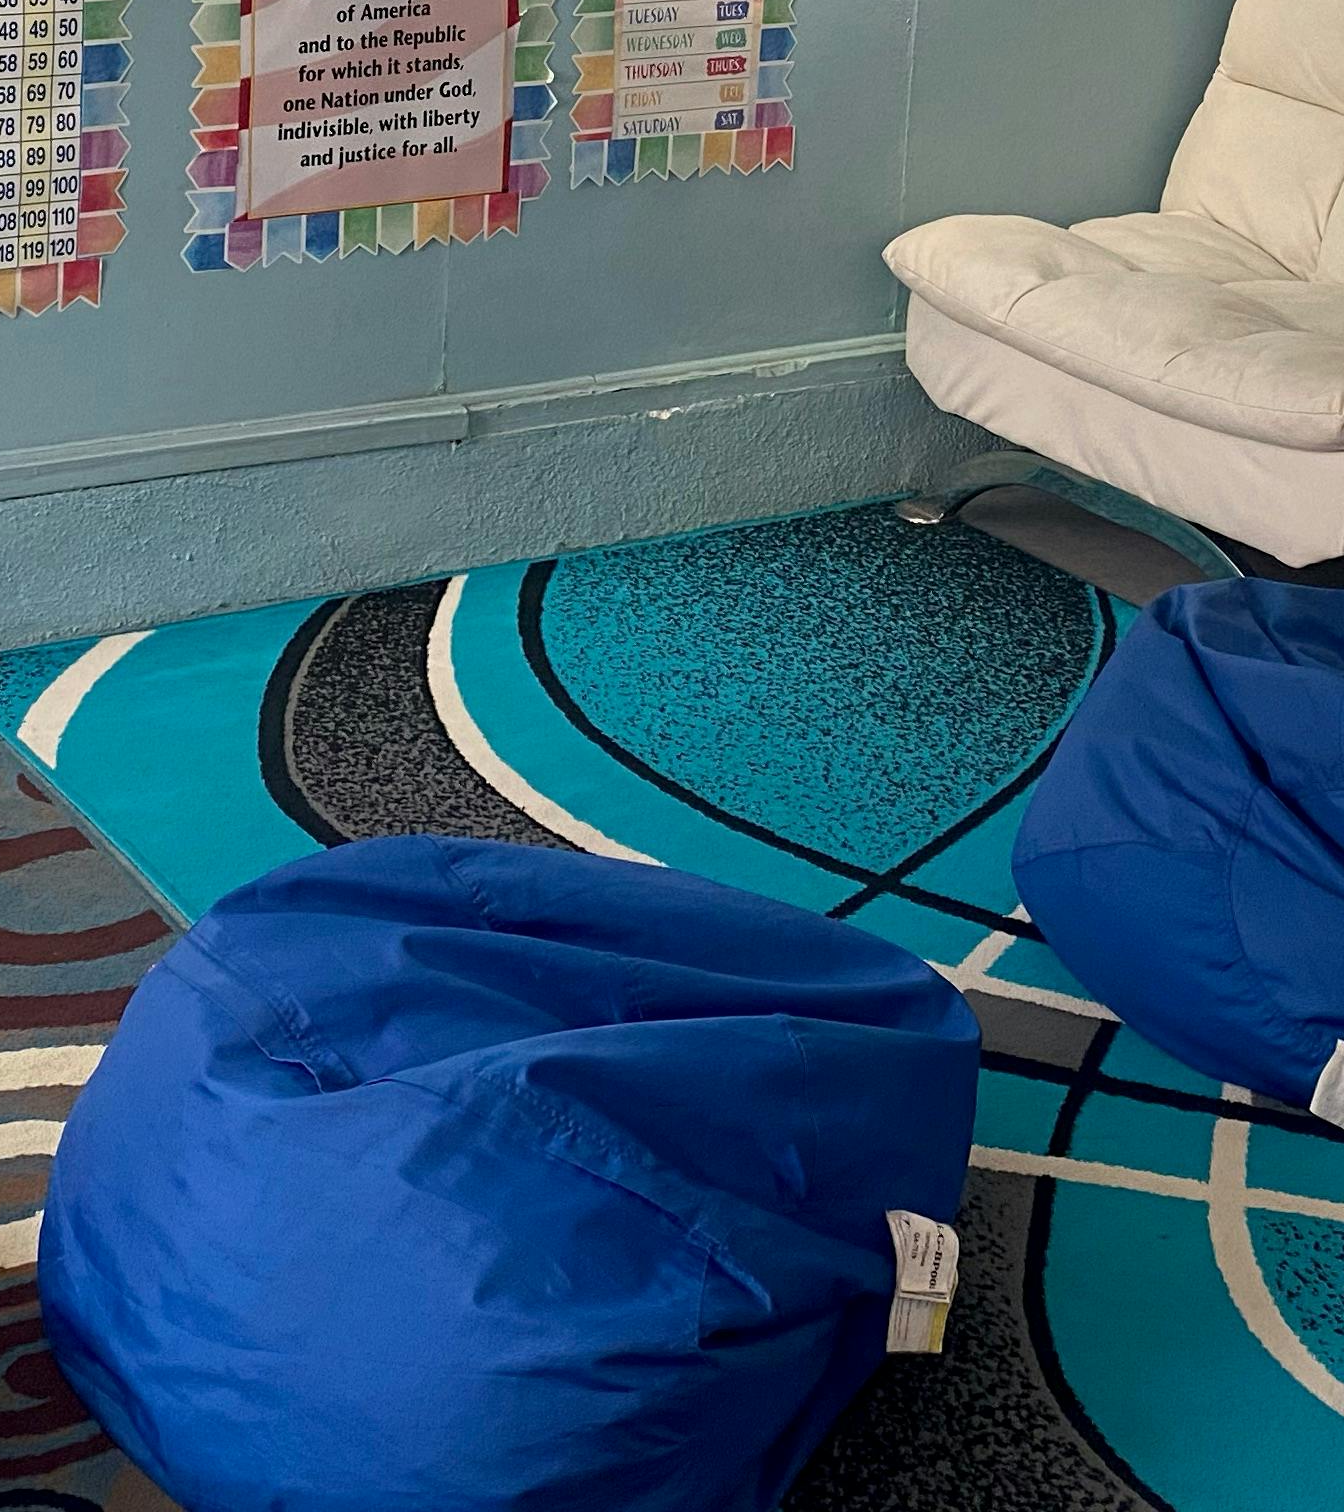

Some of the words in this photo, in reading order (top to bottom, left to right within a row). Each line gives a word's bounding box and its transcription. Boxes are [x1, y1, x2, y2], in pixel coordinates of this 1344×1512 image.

[336, 6, 355, 24] of
[360, 0, 431, 21] America
[628, 6, 680, 25] TUESDAY
[298, 34, 331, 55] and
[336, 34, 355, 51] to
[360, 31, 389, 50] the
[393, 26, 466, 49] Republic
[626, 33, 696, 53] WEDNESDAY
[299, 64, 326, 83] for
[331, 59, 383, 80] which
[387, 58, 401, 76] it
[405, 54, 465, 76] stands,
[624, 90, 664, 108] FRIDAY
[277, 117, 374, 142] indivisible,
[379, 112, 418, 133] with
[422, 108, 481, 130] liberty
[622, 117, 682, 136] SATURDAY
[338, 144, 397, 170] justice
[432, 136, 458, 155] all.
[52, 176, 78, 196] 100
